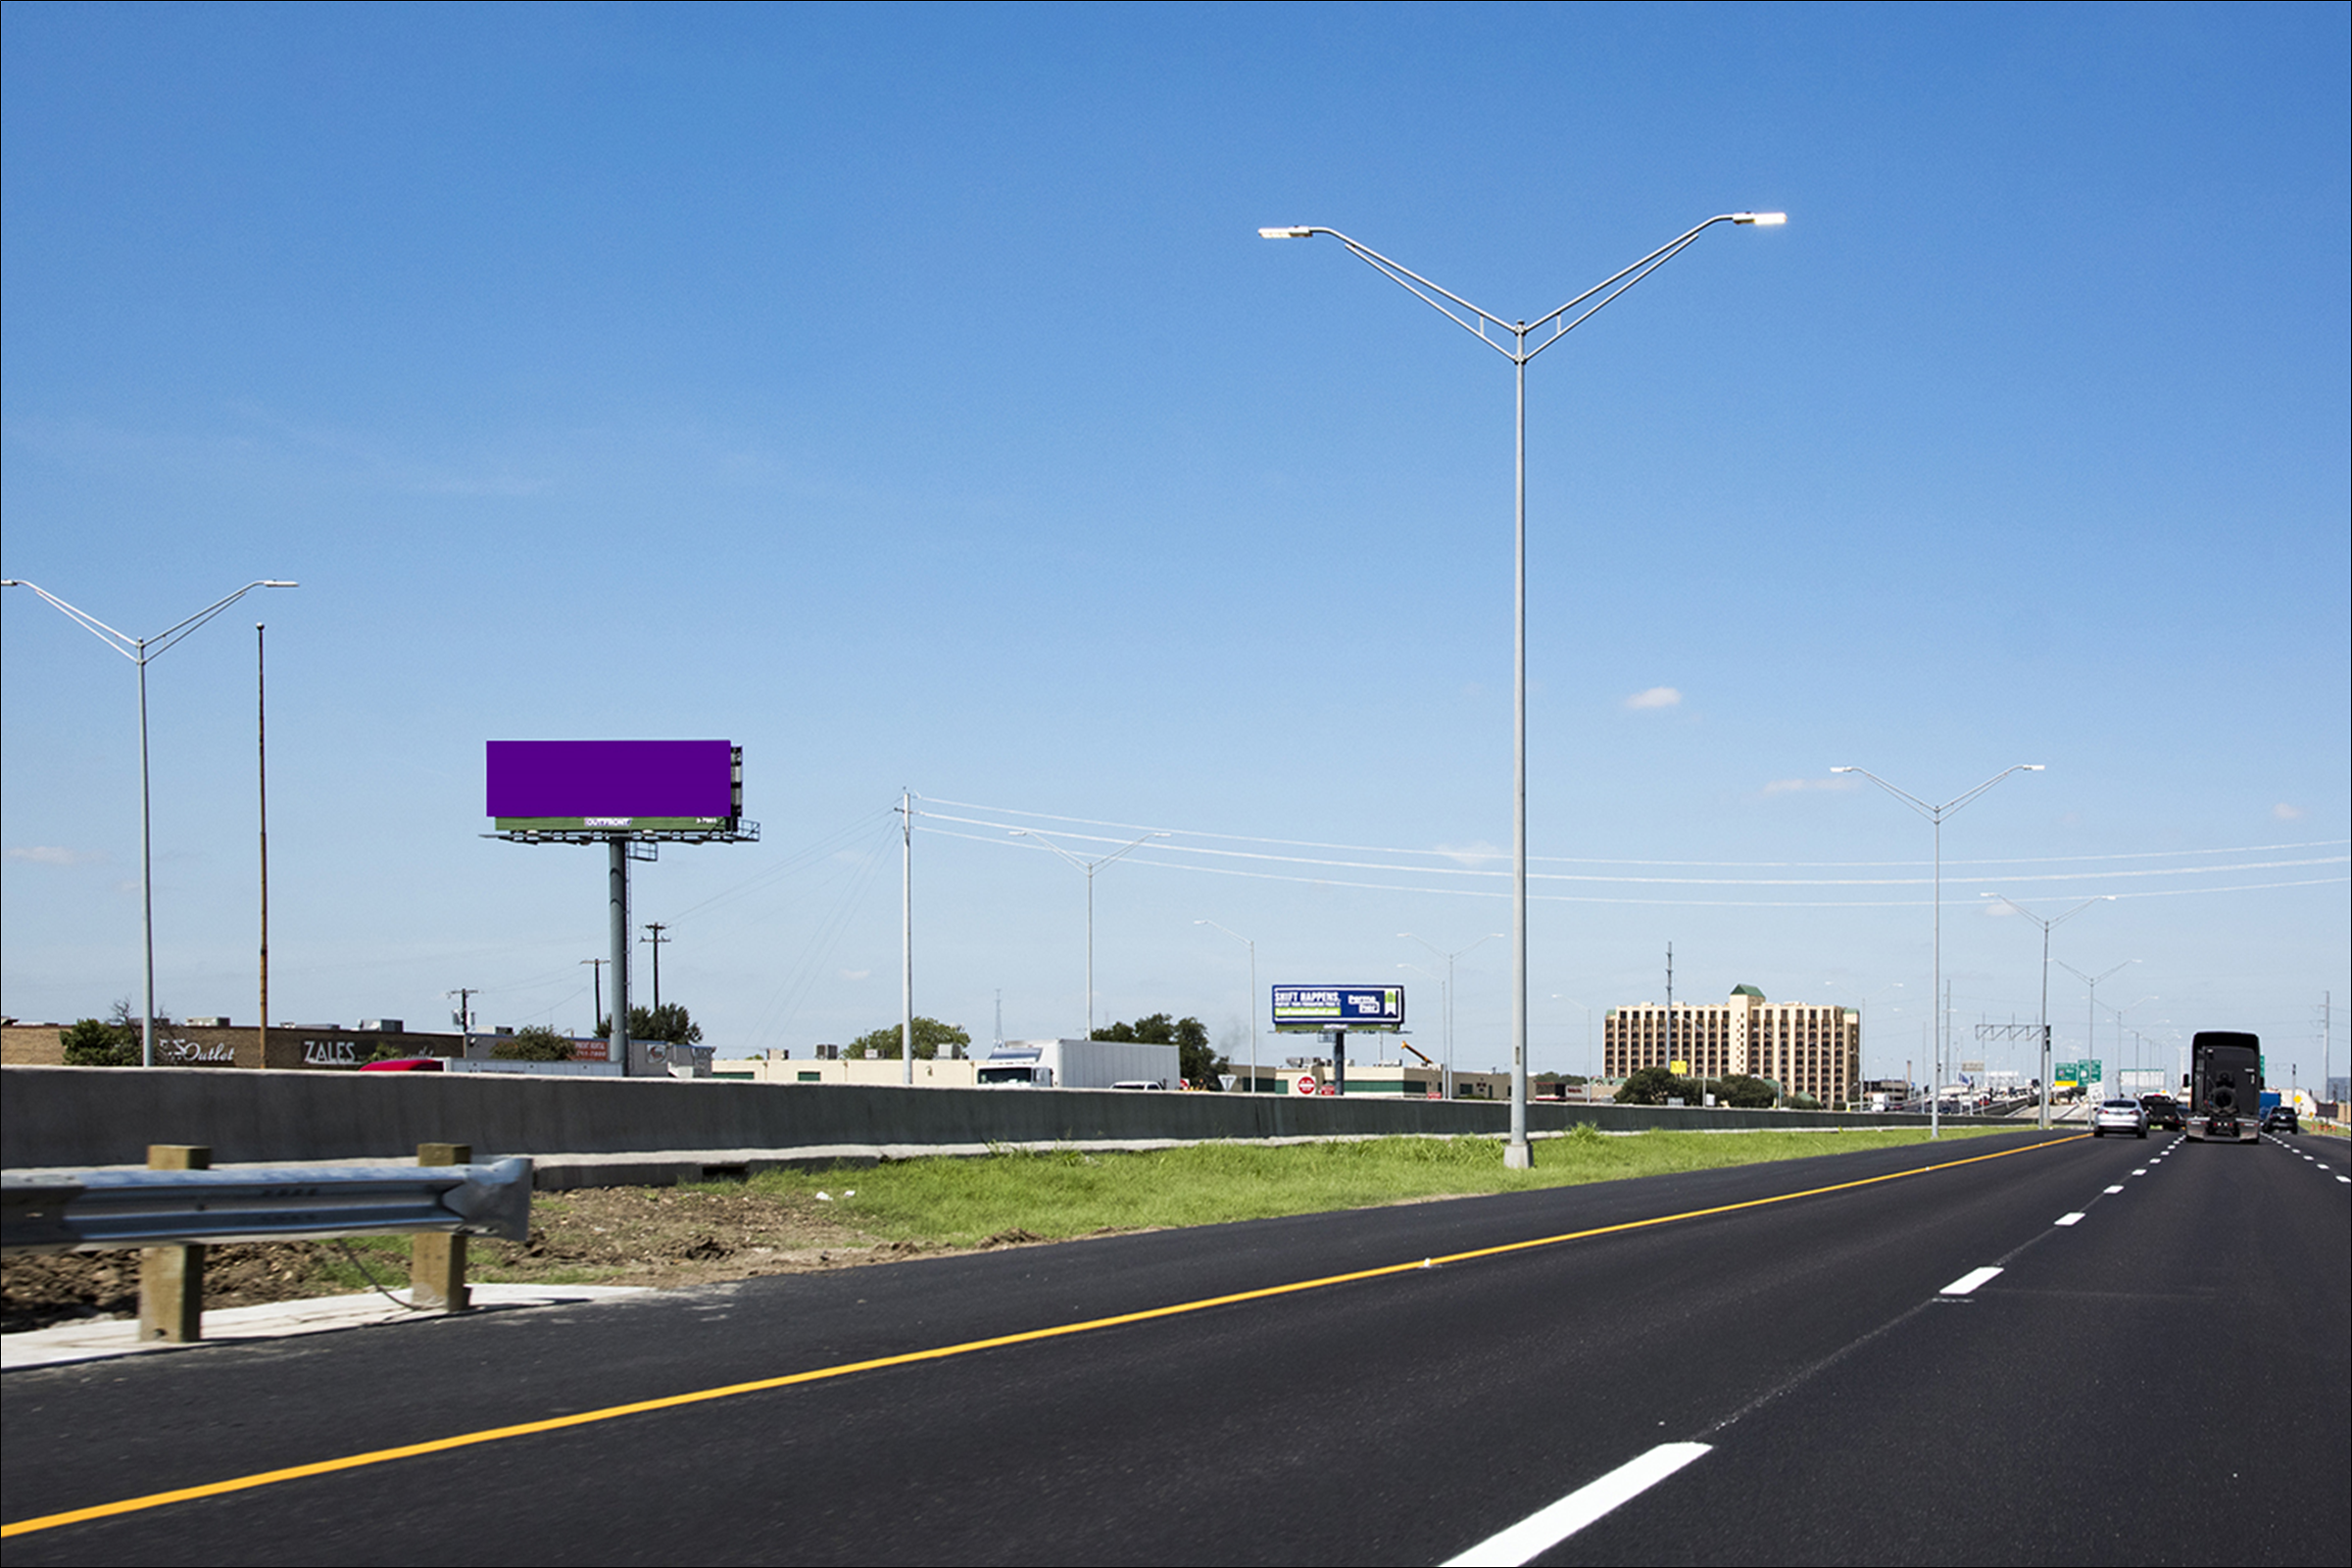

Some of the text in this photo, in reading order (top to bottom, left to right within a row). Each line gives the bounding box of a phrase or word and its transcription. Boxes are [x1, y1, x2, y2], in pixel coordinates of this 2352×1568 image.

[1275, 992, 1298, 1002] SHIFT
[183, 1042, 234, 1061] Outlet
[304, 1041, 355, 1062] ZALES
